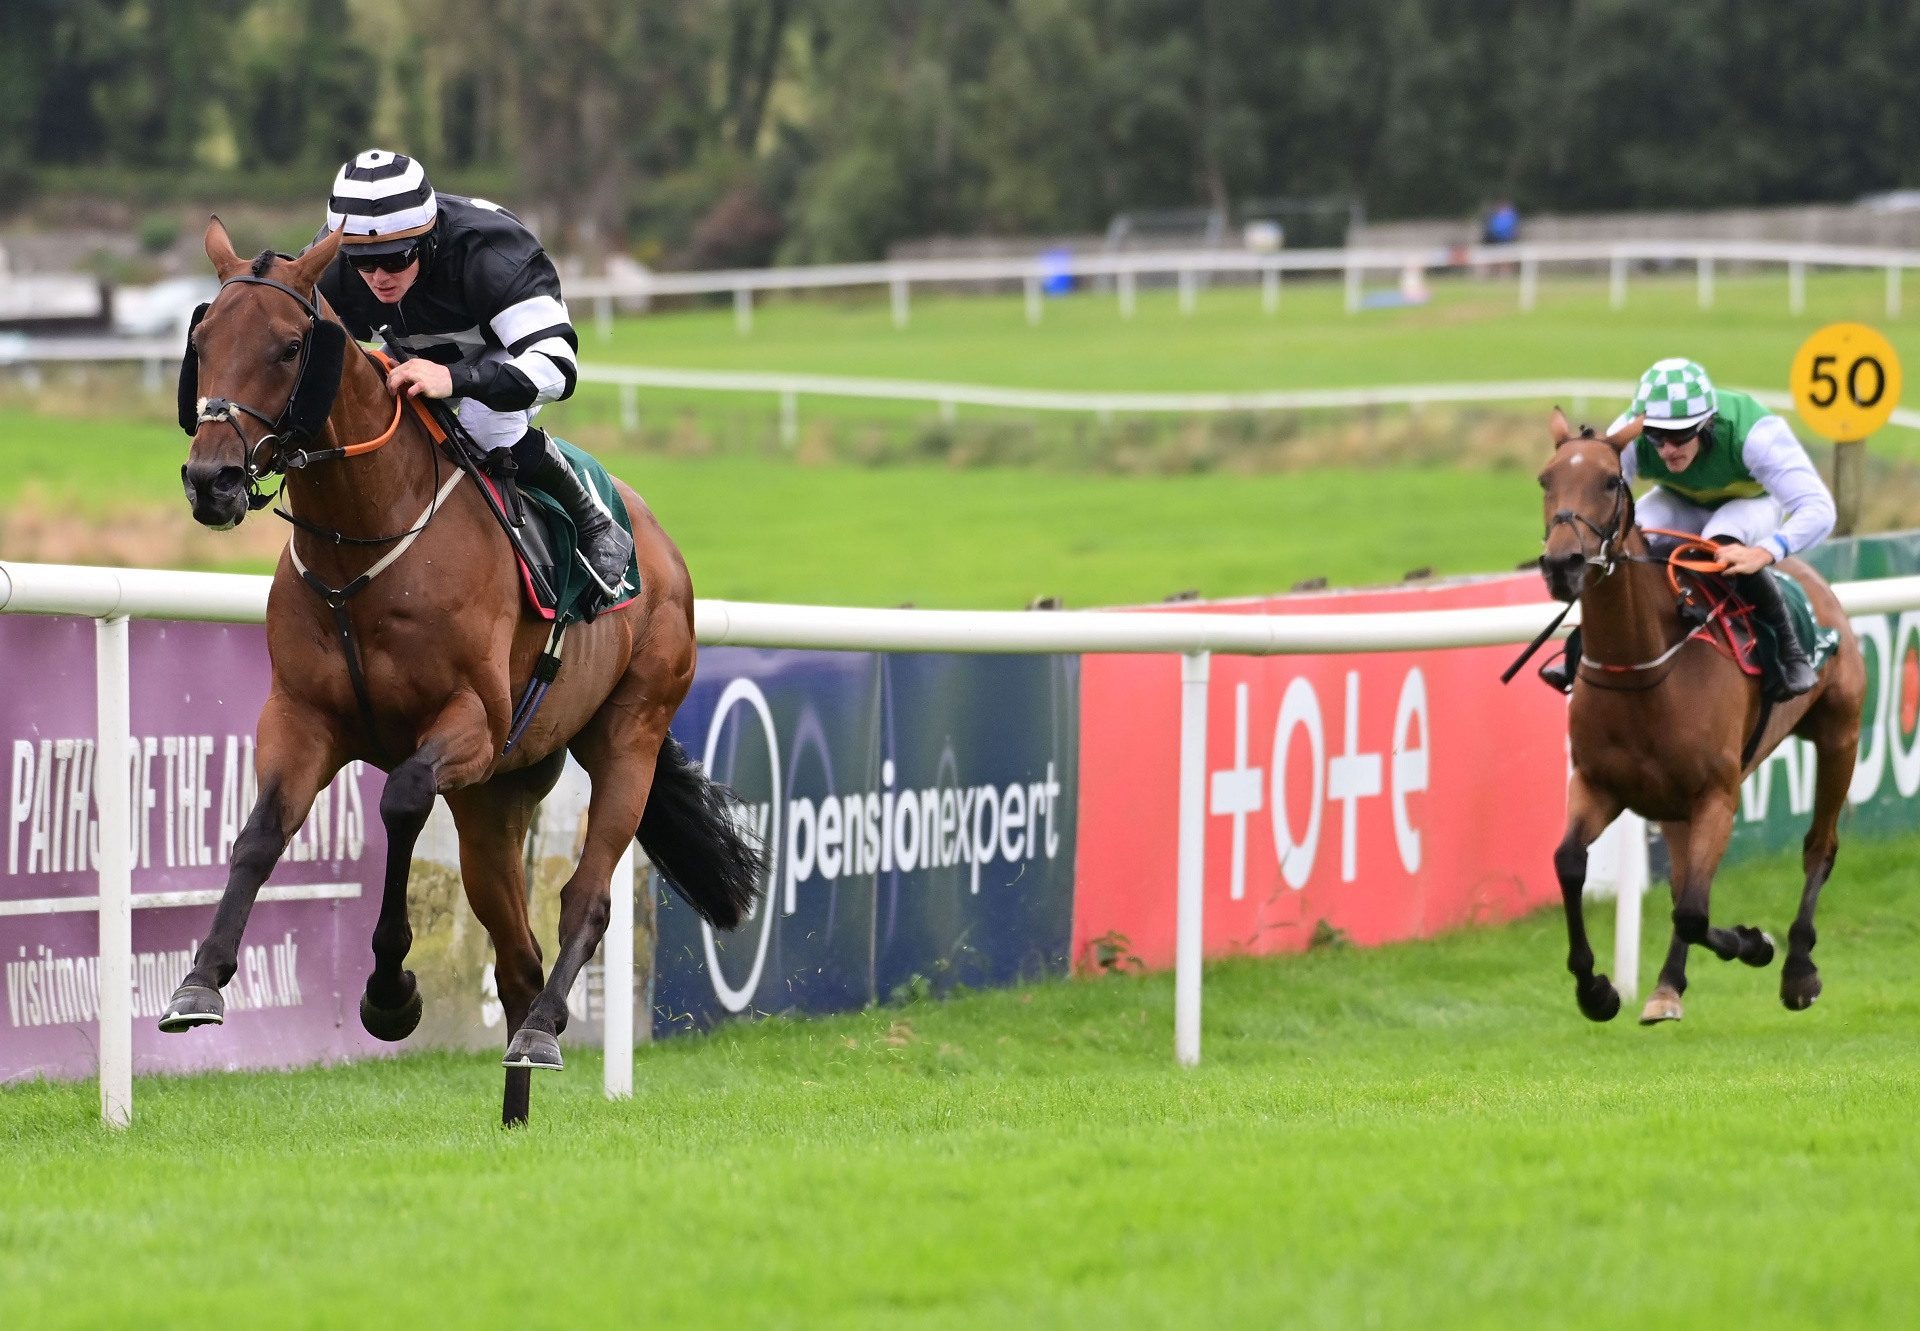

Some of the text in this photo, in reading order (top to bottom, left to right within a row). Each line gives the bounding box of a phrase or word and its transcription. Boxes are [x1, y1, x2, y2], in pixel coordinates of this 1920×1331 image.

[1808, 355, 1886, 409] 50
[130, 735, 158, 870] OF
[163, 735, 214, 868] THE
[784, 760, 1060, 915] pensionexpert
[1210, 666, 1430, 900] tote
